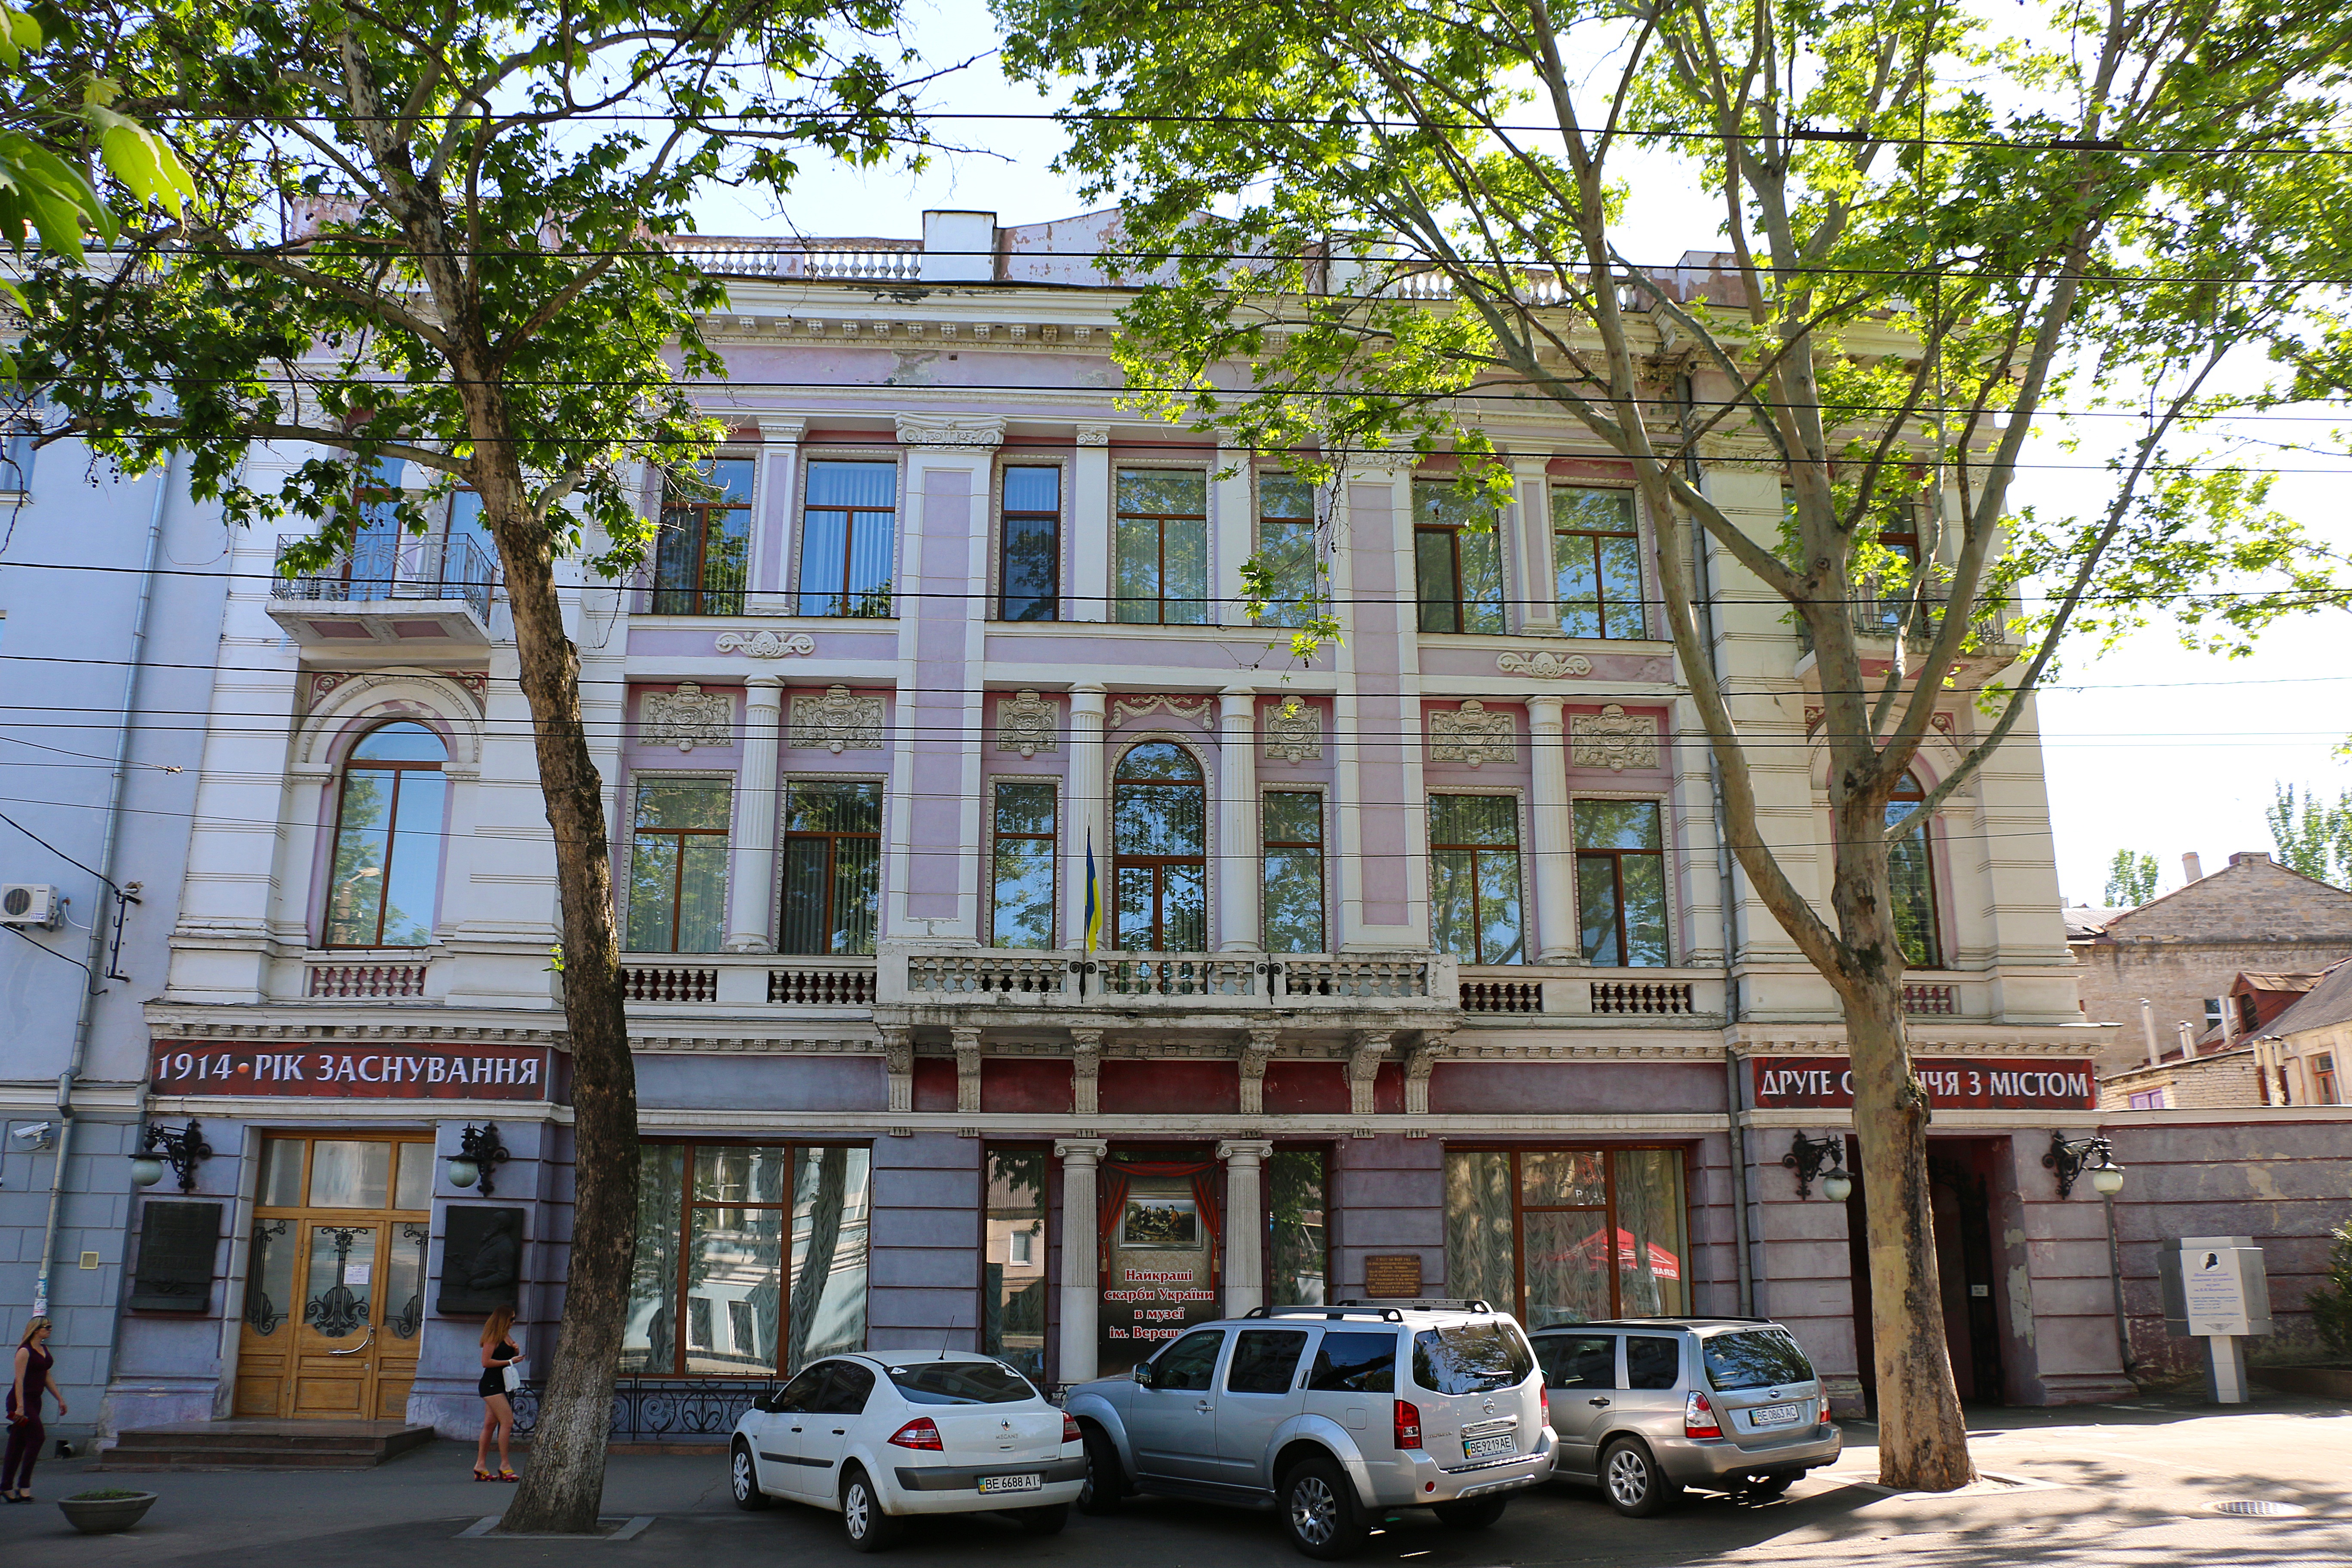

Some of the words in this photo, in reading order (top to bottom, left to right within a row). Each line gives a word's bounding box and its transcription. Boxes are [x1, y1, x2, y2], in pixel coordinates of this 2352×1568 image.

[159, 1053, 233, 1081] 1914
[254, 1054, 306, 1081] РІК
[316, 1054, 539, 1085] ЗАСНУВАННЯ
[1761, 1070, 1834, 1096] ДРУГЕ
[1968, 1071, 1982, 1096] З
[1990, 1072, 2089, 1097] МІСТОМ
[1125, 1269, 1193, 1283] Найкращі
[1104, 1287, 1155, 1303] скарби
[1158, 1288, 1214, 1303] України
[1134, 1310, 1143, 1319] в
[1146, 1307, 1185, 1322] музеї
[1109, 1326, 1129, 1338] ім.
[1756, 1411, 1768, 1421] BE
[1786, 1407, 1796, 1418] AC
[986, 1479, 1000, 1490] BE
[1002, 1477, 1023, 1488] 6688
[1026, 1476, 1036, 1486] AI
